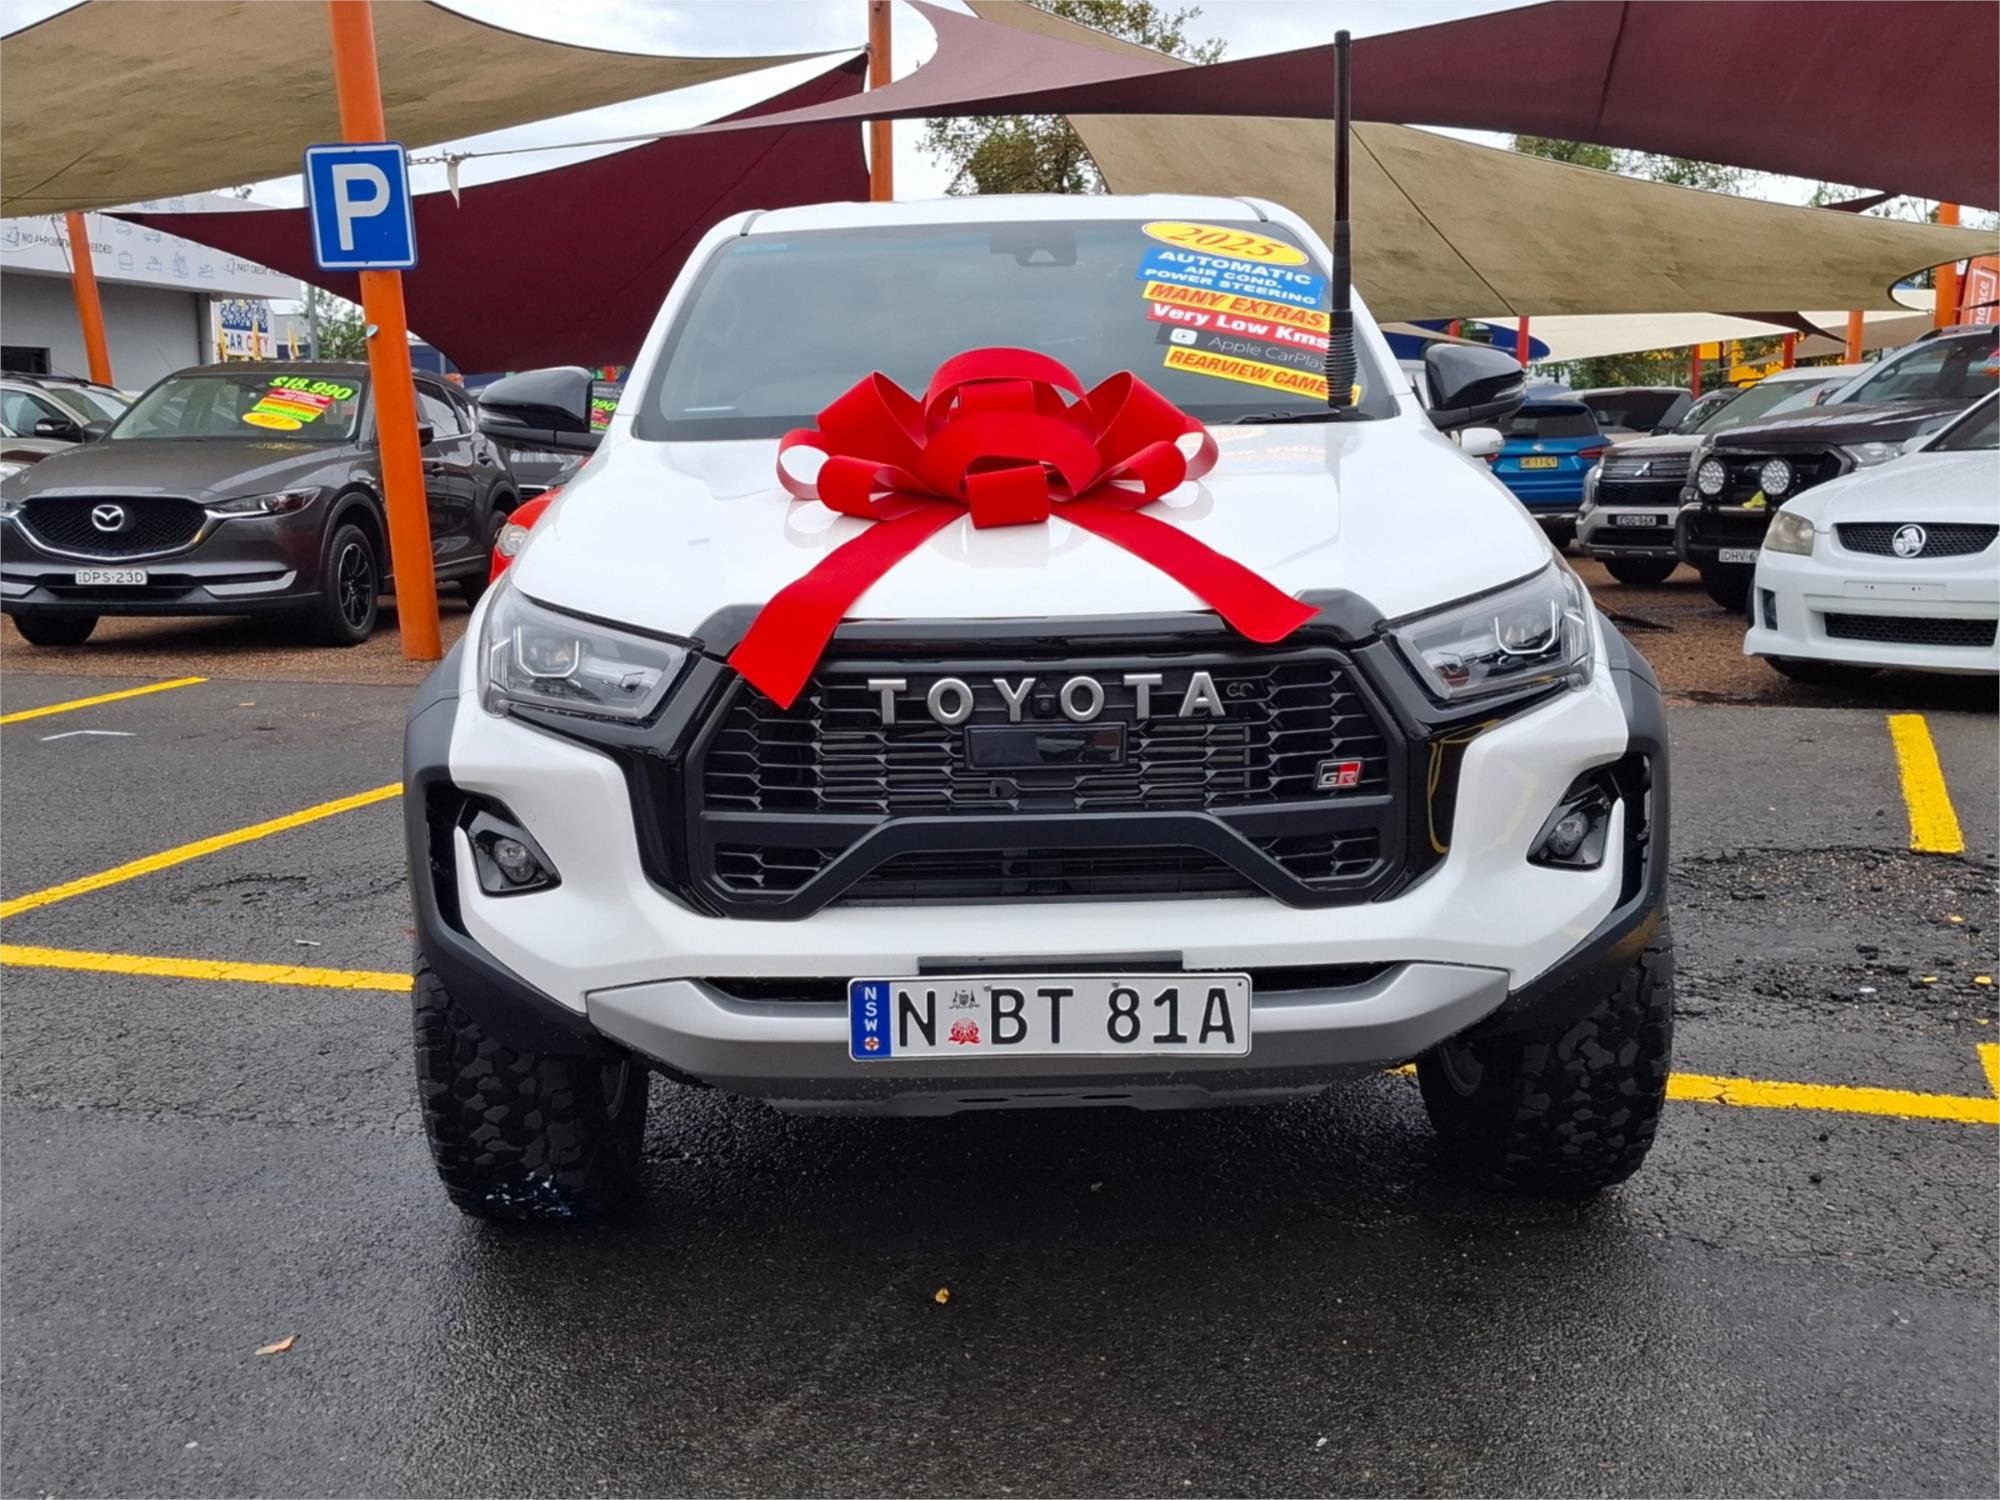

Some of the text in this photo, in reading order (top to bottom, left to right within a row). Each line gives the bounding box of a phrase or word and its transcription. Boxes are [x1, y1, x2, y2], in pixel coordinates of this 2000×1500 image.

[331, 163, 391, 251] P
[90, 242, 113, 254] EEDED
[1167, 227, 1284, 256] 2025
[1144, 268, 1317, 305] POWER STEERING
[1157, 250, 1312, 285] AUTOMATIC
[1184, 265, 1283, 289] AIR COND.
[1149, 283, 1327, 328] MANY EXTRAS
[1153, 303, 1330, 349] Very Low Kms
[1168, 350, 1329, 395] REARVIEW CAME
[1207, 336, 1327, 371] Apple CarPlay
[868, 671, 1226, 726] TOYOTA
[1320, 771, 1357, 786] GR
[863, 986, 879, 1033] NSW
[1106, 987, 1236, 1044] 81A
